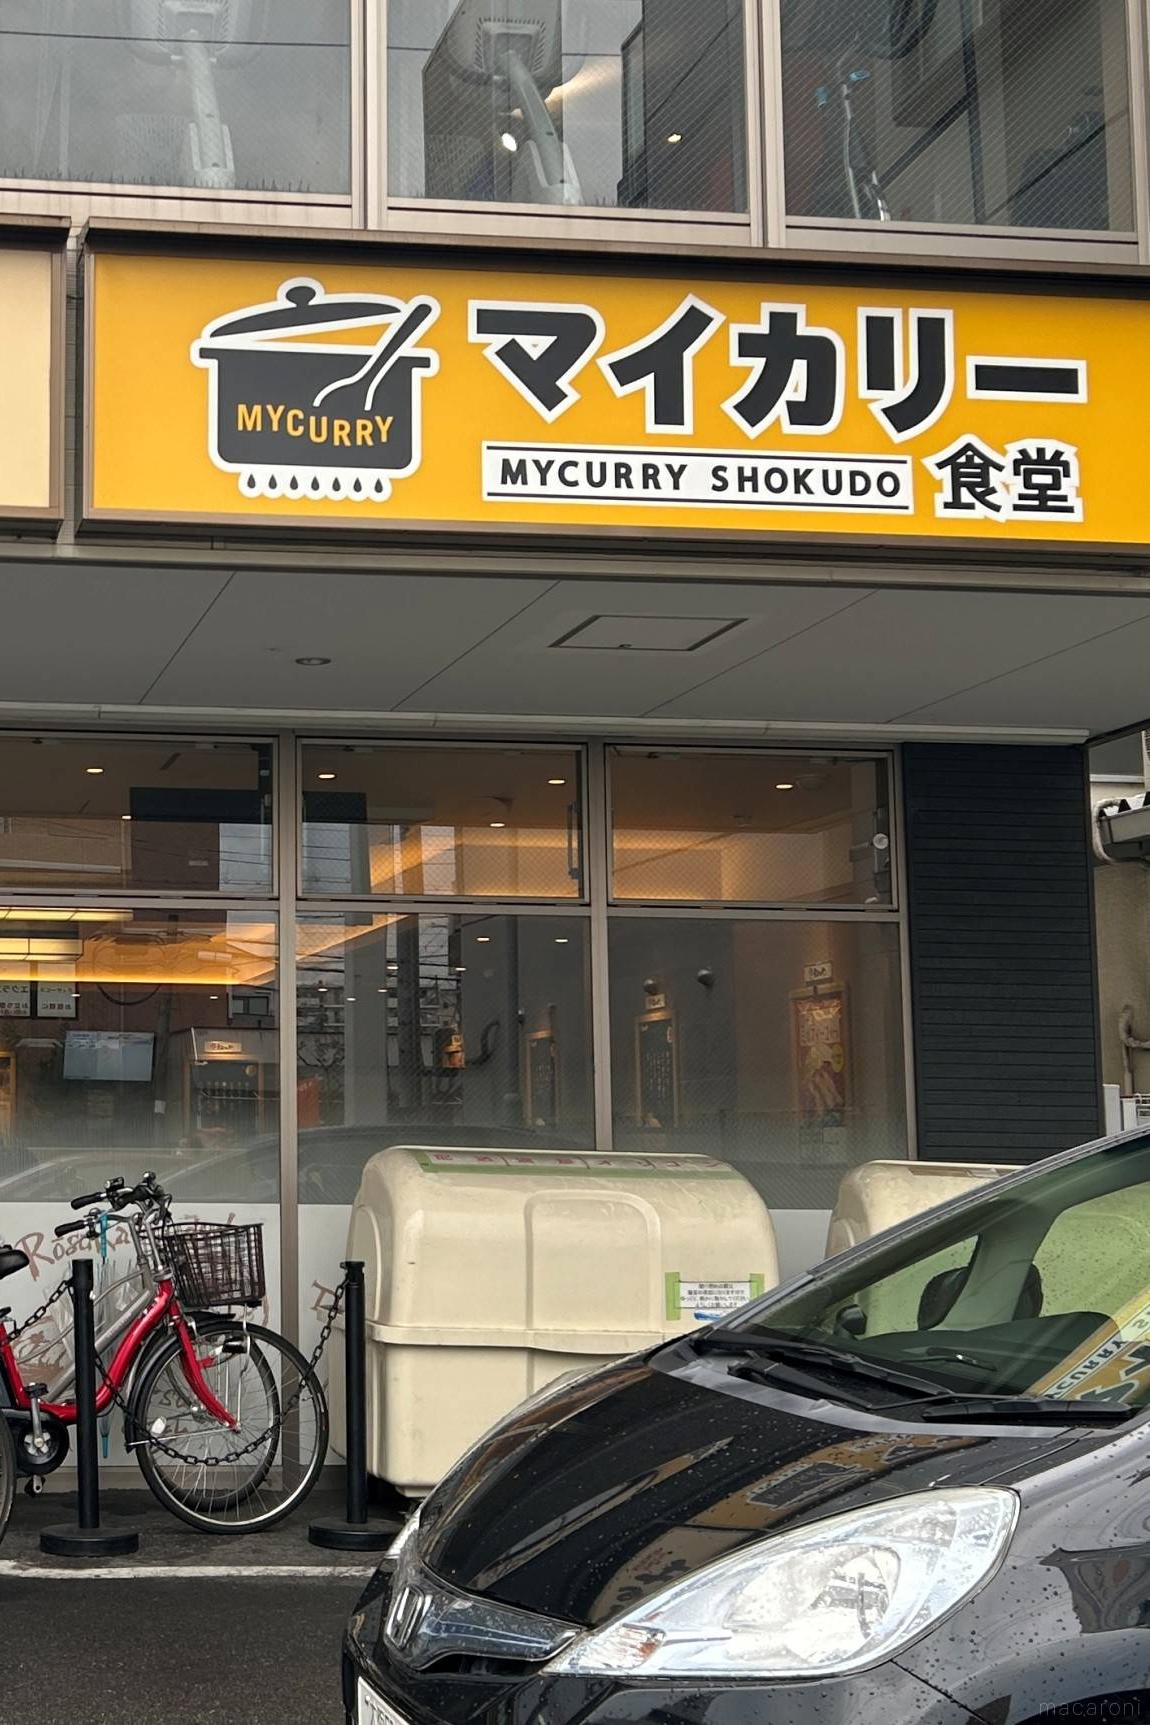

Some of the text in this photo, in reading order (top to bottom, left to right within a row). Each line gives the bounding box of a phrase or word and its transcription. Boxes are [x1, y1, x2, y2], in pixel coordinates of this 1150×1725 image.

[470, 297, 1085, 438] マイカリー
[236, 402, 395, 447] MYCURRY
[499, 459, 902, 499] MYCURRY SHOKUDO
[935, 438, 1076, 518] 食堂
